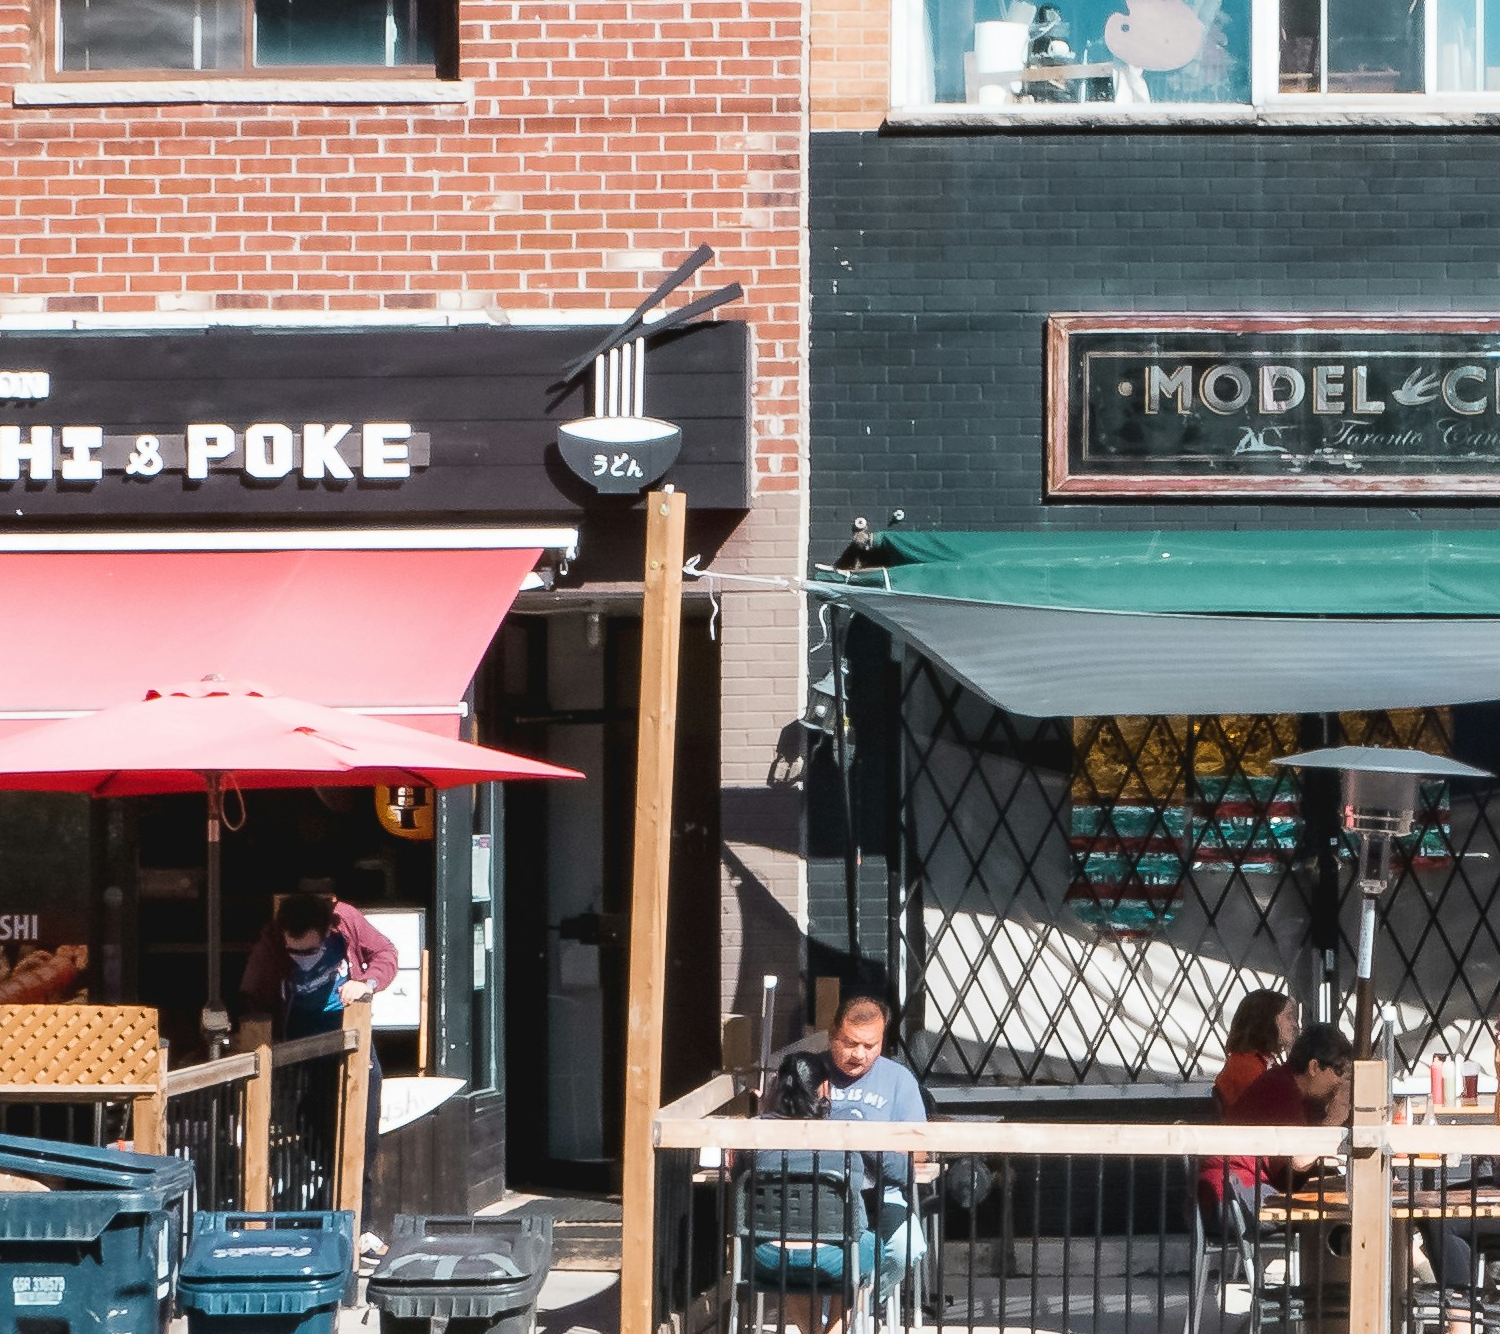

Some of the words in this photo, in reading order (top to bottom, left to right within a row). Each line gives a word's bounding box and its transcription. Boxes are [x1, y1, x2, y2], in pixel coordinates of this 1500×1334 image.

[1144, 365, 1386, 415] MODEL
[127, 434, 163, 476] &
[188, 423, 411, 478] POKE
[1332, 419, 1423, 447] Toronto
[593, 452, 644, 478] うどん
